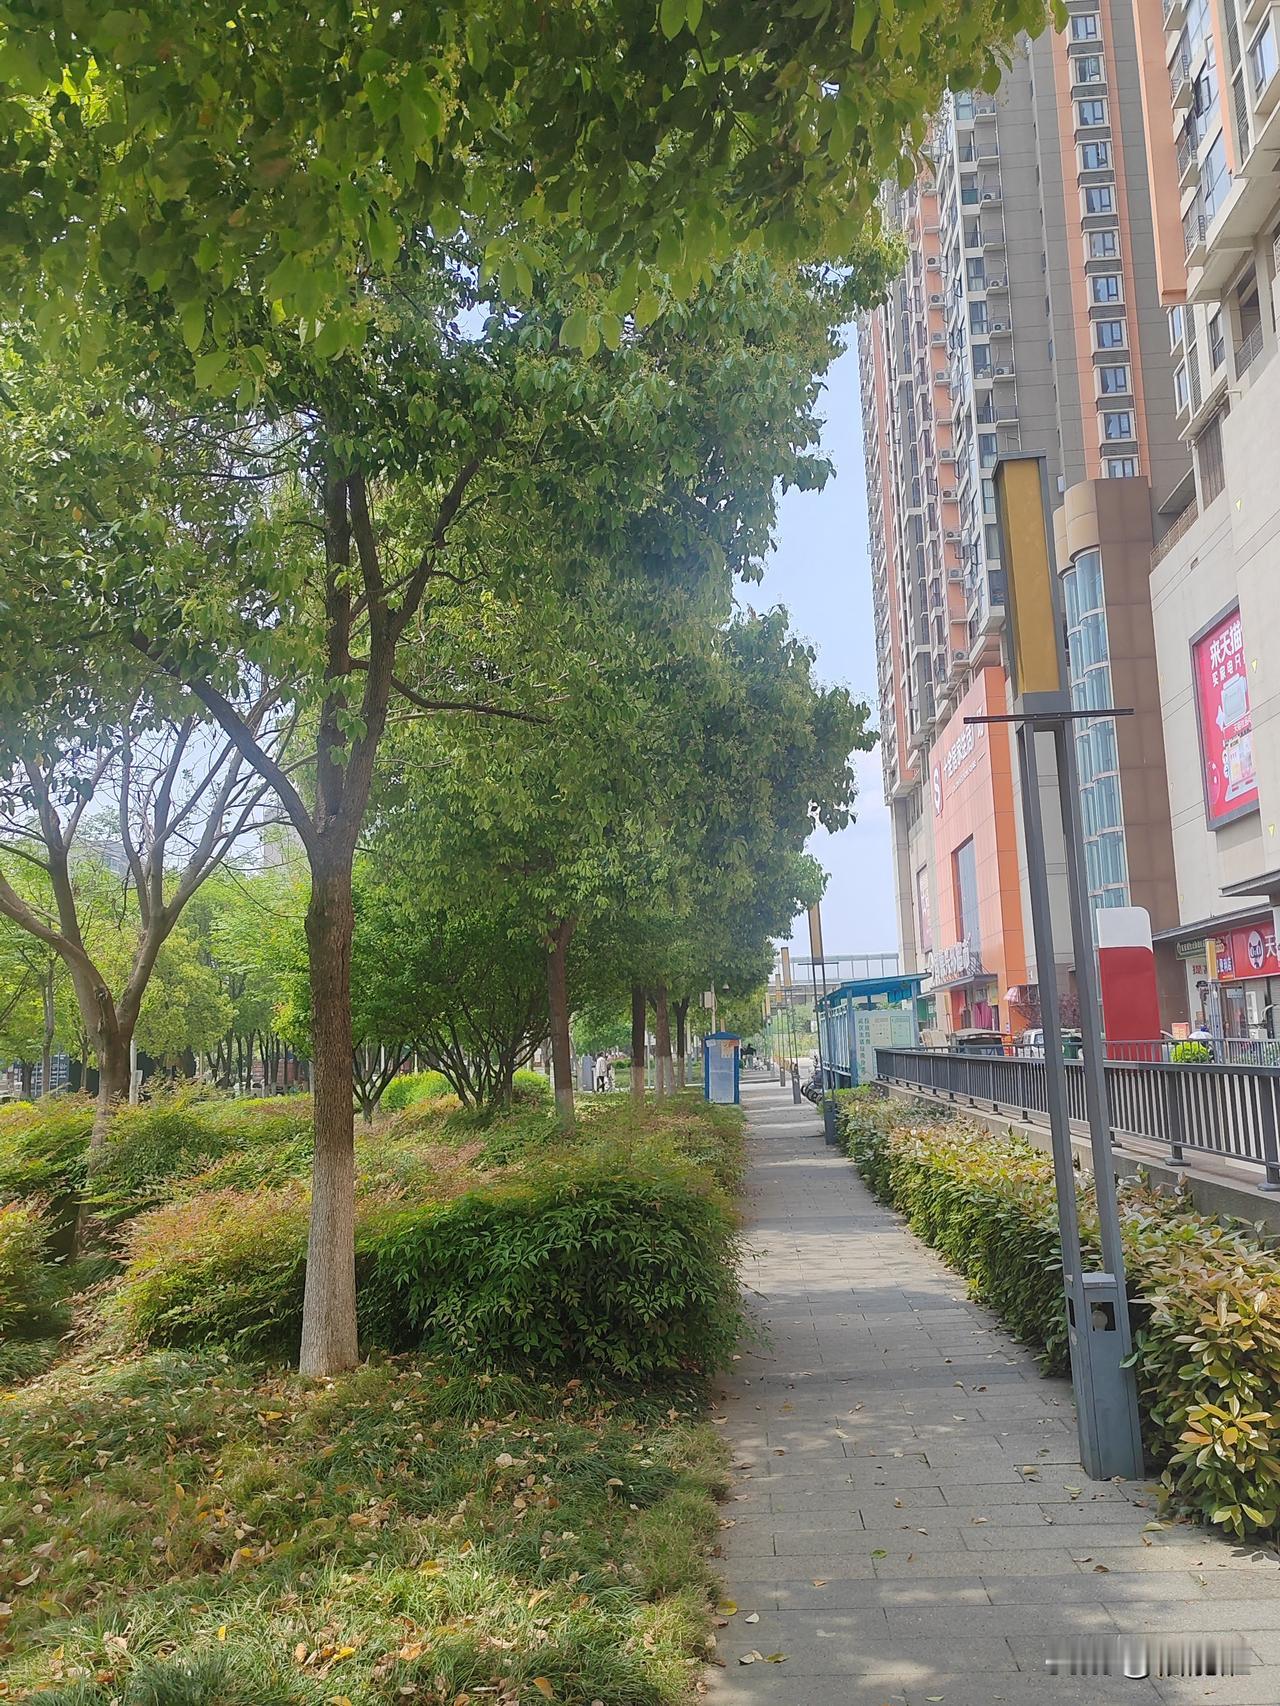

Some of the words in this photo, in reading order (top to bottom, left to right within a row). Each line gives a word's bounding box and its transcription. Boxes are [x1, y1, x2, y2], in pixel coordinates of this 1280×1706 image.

[1209, 620, 1243, 670] 来天猫
[1211, 650, 1246, 687] 买家电只
[1264, 934, 1277, 958] 天
